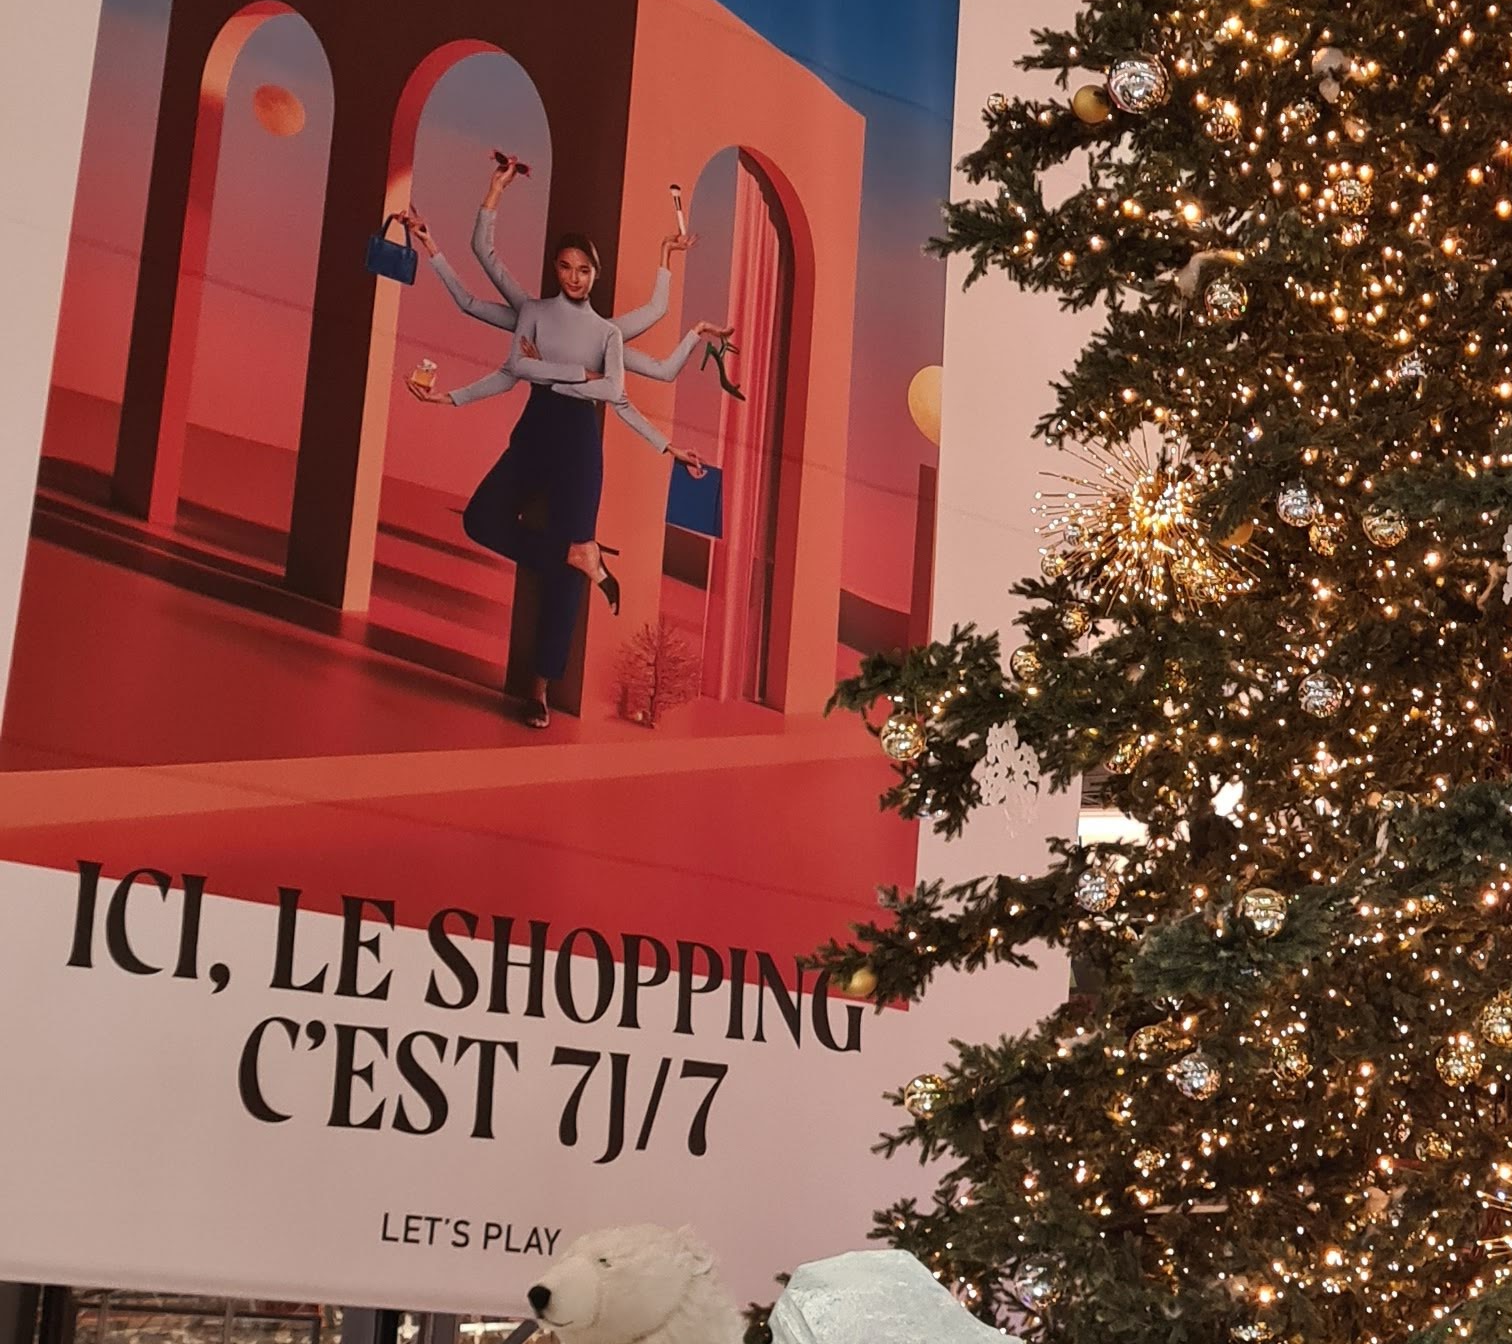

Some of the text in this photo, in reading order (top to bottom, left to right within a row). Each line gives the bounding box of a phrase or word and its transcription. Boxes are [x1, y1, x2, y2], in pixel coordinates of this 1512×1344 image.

[66, 860, 865, 1053] ICI, LE SHOPPING
[238, 1016, 729, 1164] C'EST 7J/7
[381, 1212, 562, 1256] LET'S PLAY
